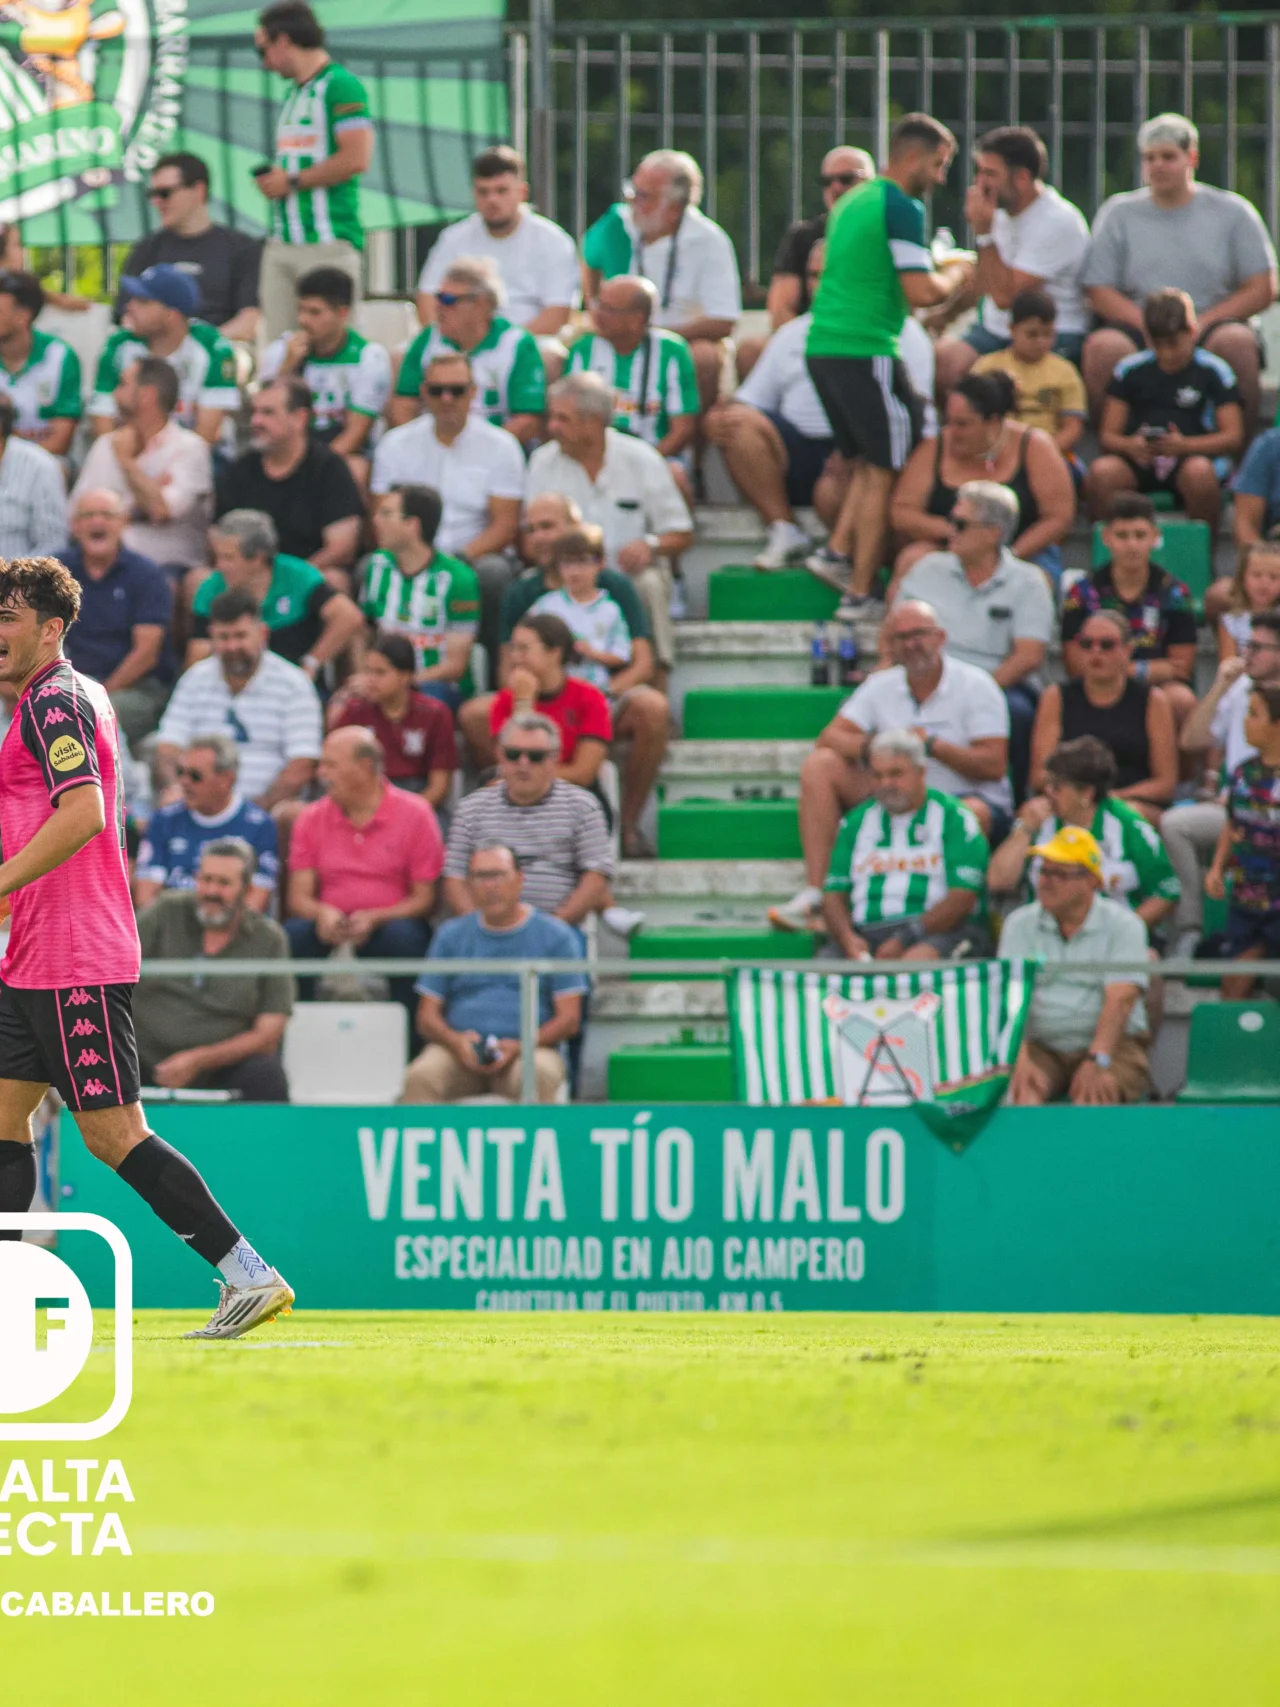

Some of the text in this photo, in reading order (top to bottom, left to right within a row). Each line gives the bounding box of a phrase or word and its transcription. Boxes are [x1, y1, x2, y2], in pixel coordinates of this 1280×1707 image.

[54, 742, 77, 758] visit
[357, 1111, 905, 1223] VENTA TÍO MALO
[395, 1235, 865, 1281] ESPECIALIDAD EN AJO CAMPERO
